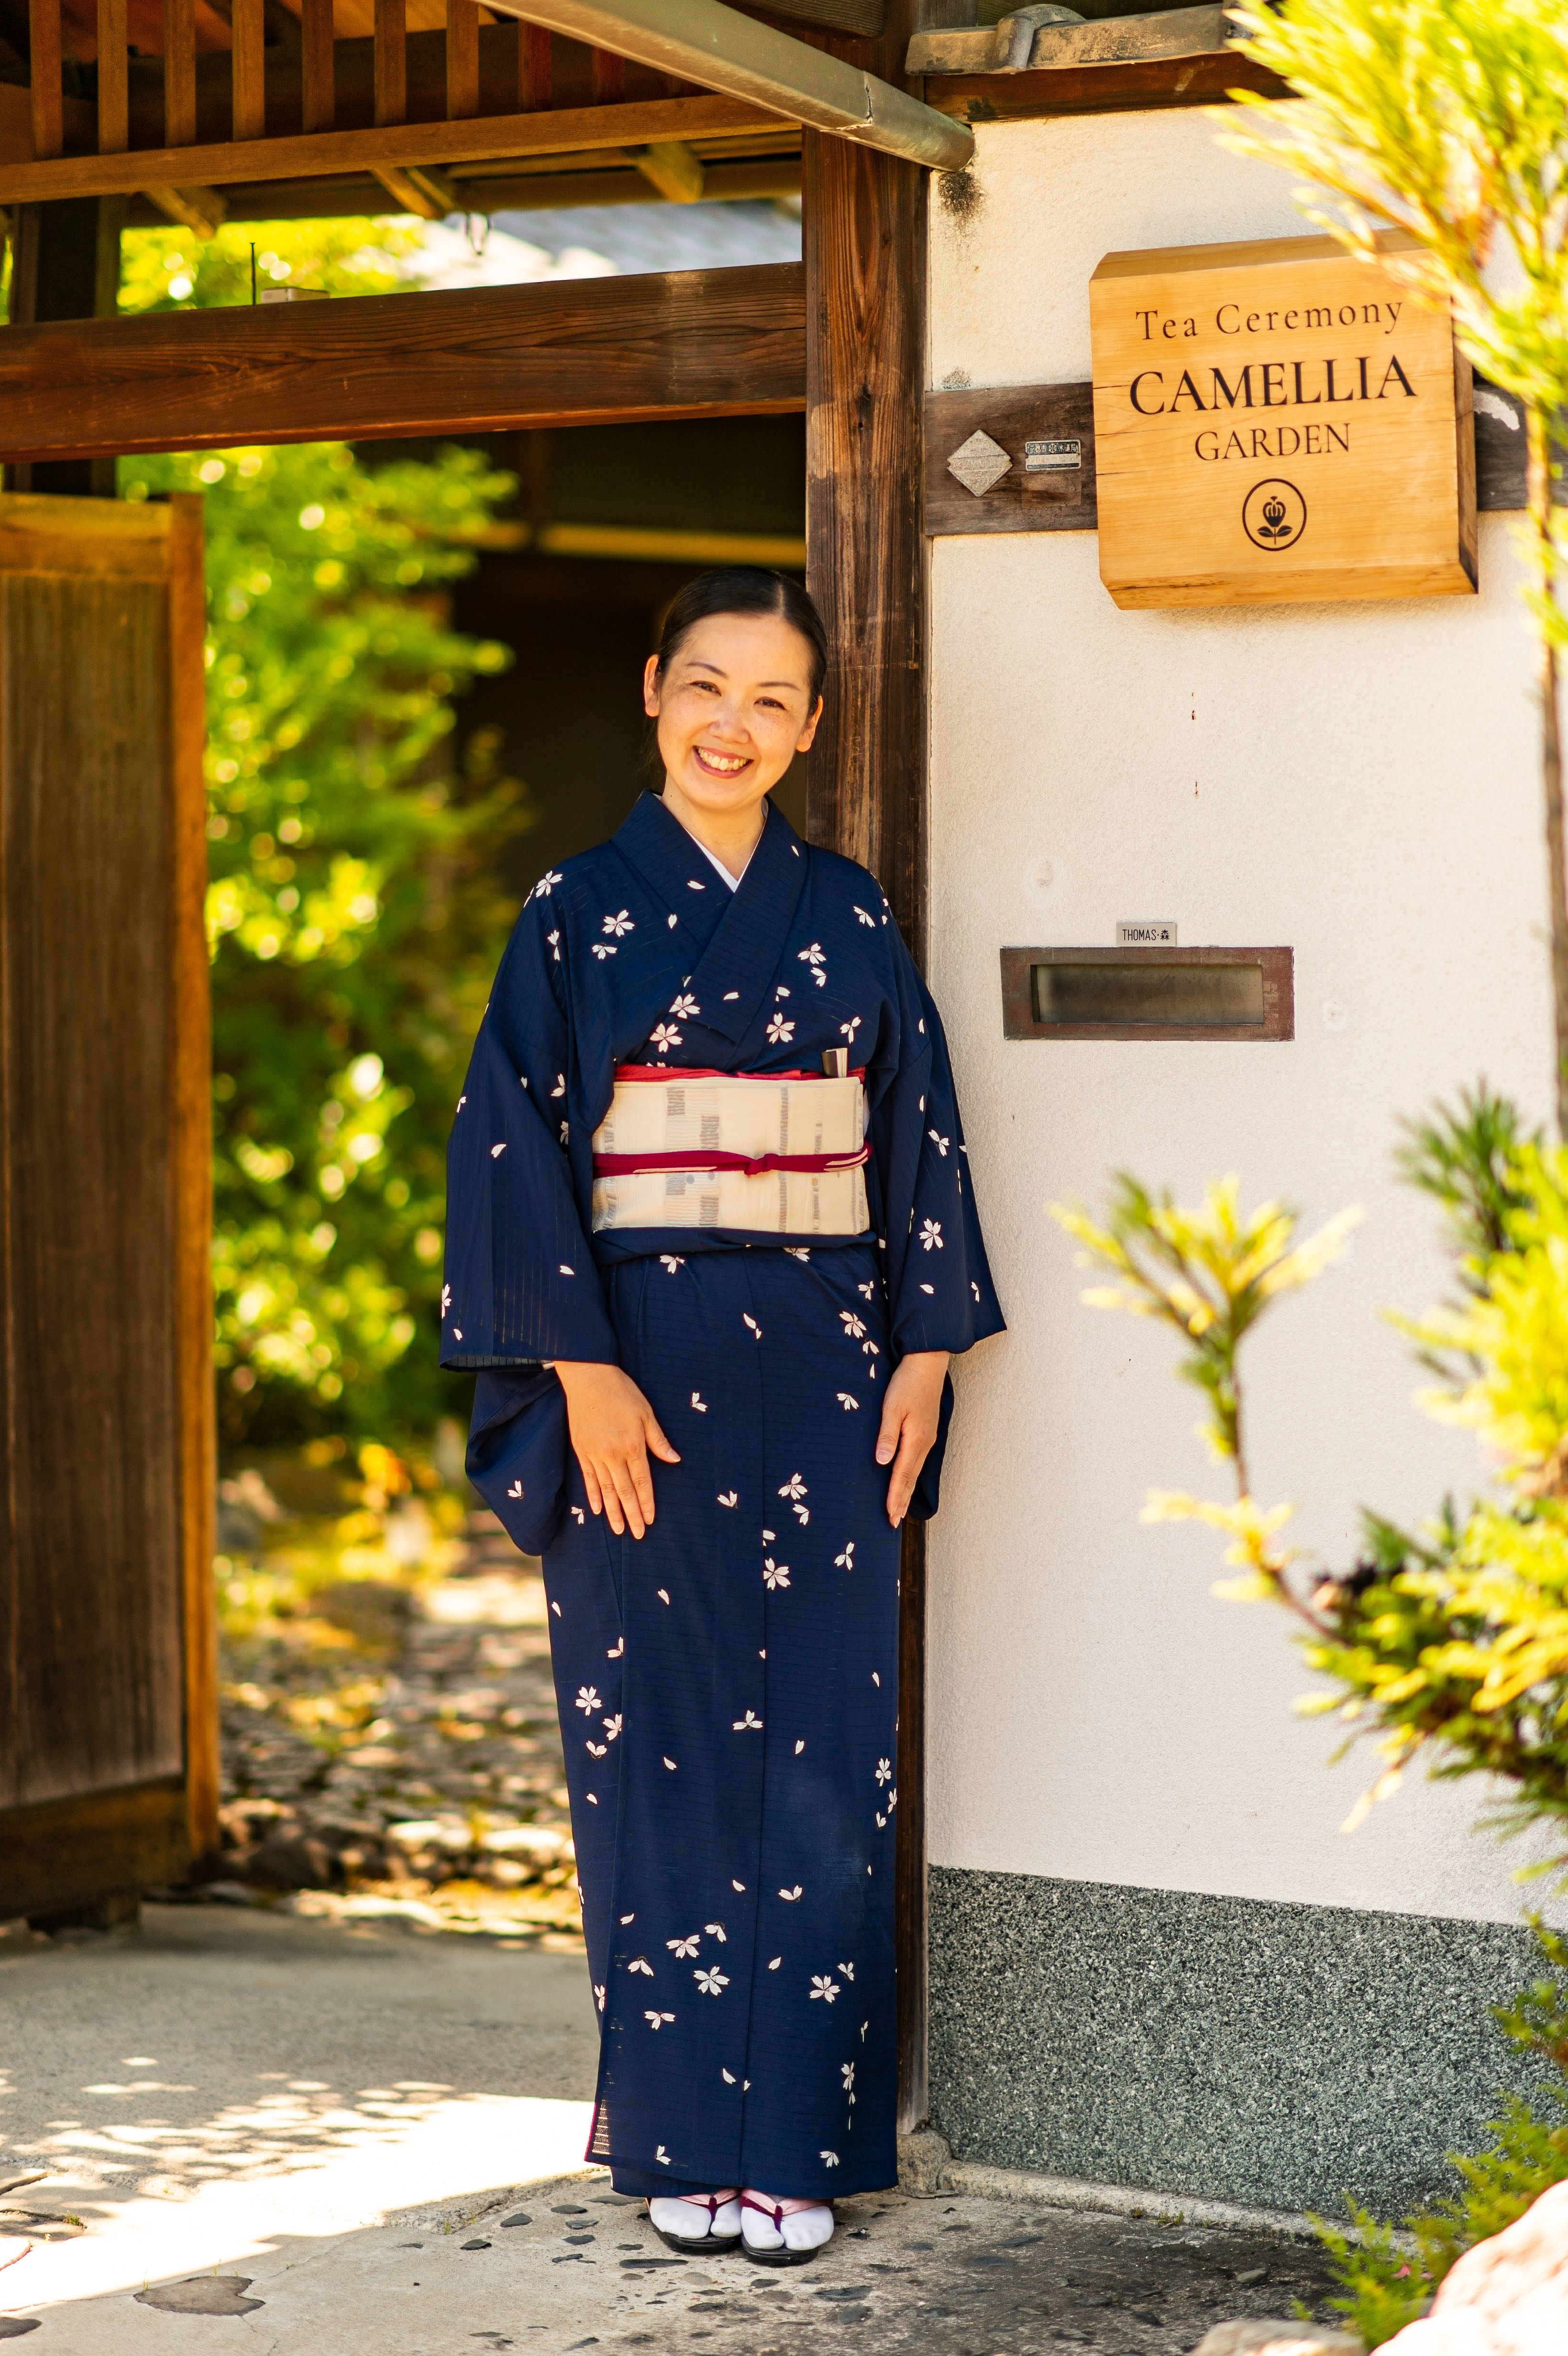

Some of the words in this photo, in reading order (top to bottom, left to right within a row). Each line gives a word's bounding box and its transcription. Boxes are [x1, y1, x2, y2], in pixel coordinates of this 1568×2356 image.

[1135, 309, 1198, 340] Tea
[1216, 301, 1404, 335] Ceremony
[1129, 354, 1418, 415] CAMELLIA
[1194, 423, 1351, 461] GARDEN
